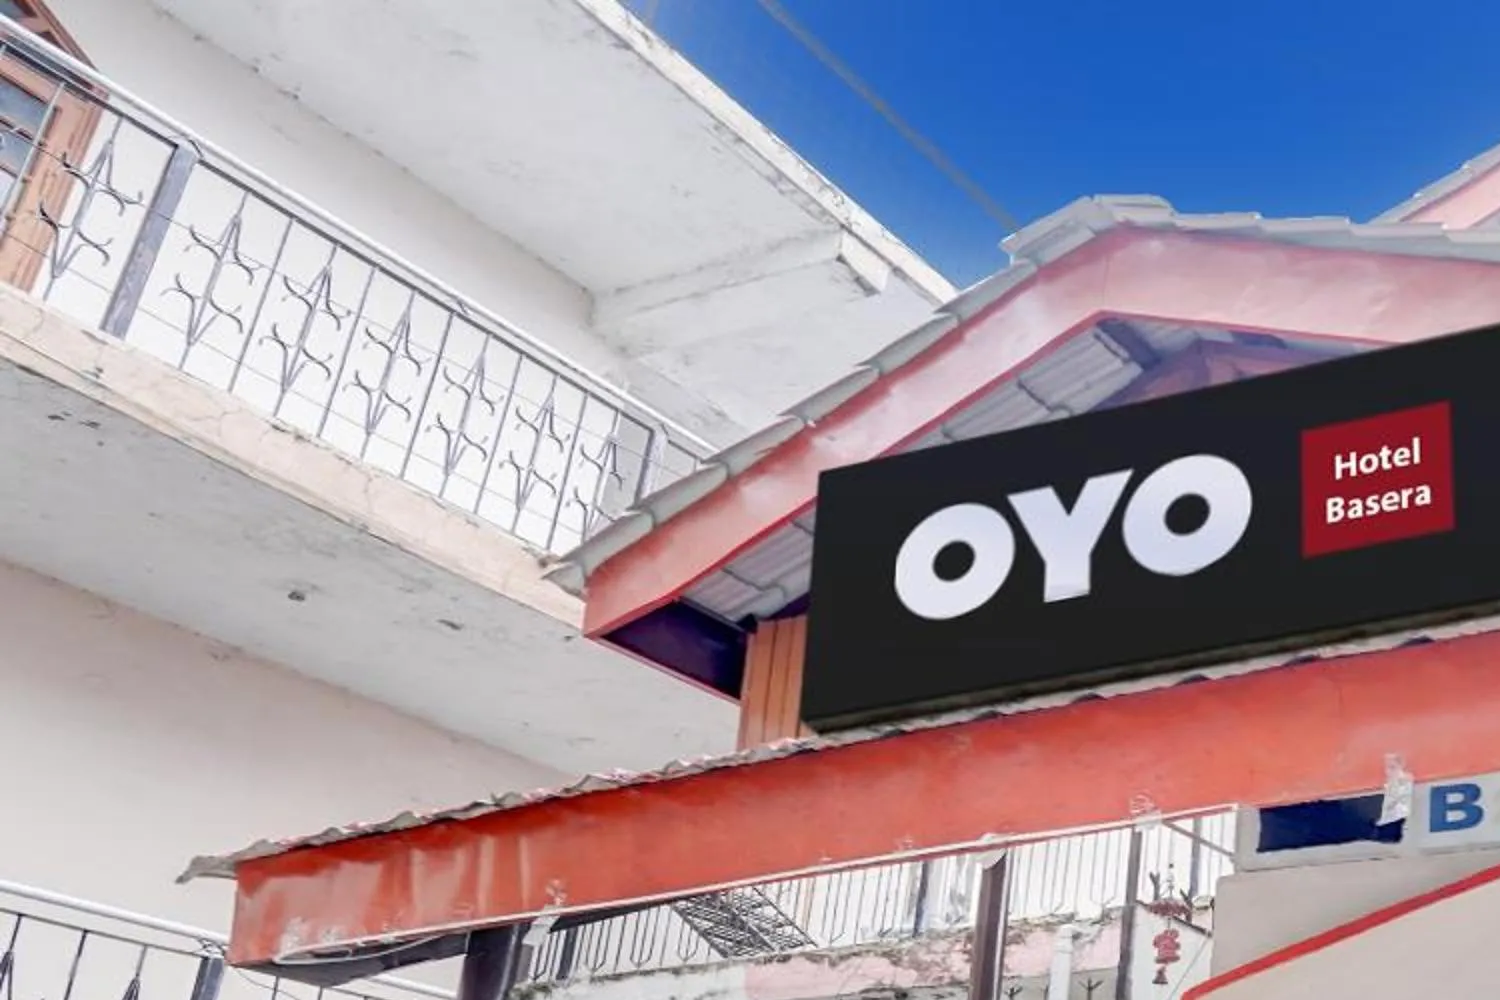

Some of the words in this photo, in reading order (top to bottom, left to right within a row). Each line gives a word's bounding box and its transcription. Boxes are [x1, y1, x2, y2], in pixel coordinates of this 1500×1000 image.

[1334, 436, 1421, 480] Hotel
[1326, 484, 1431, 524] Basera
[895, 454, 1252, 620] OYO
